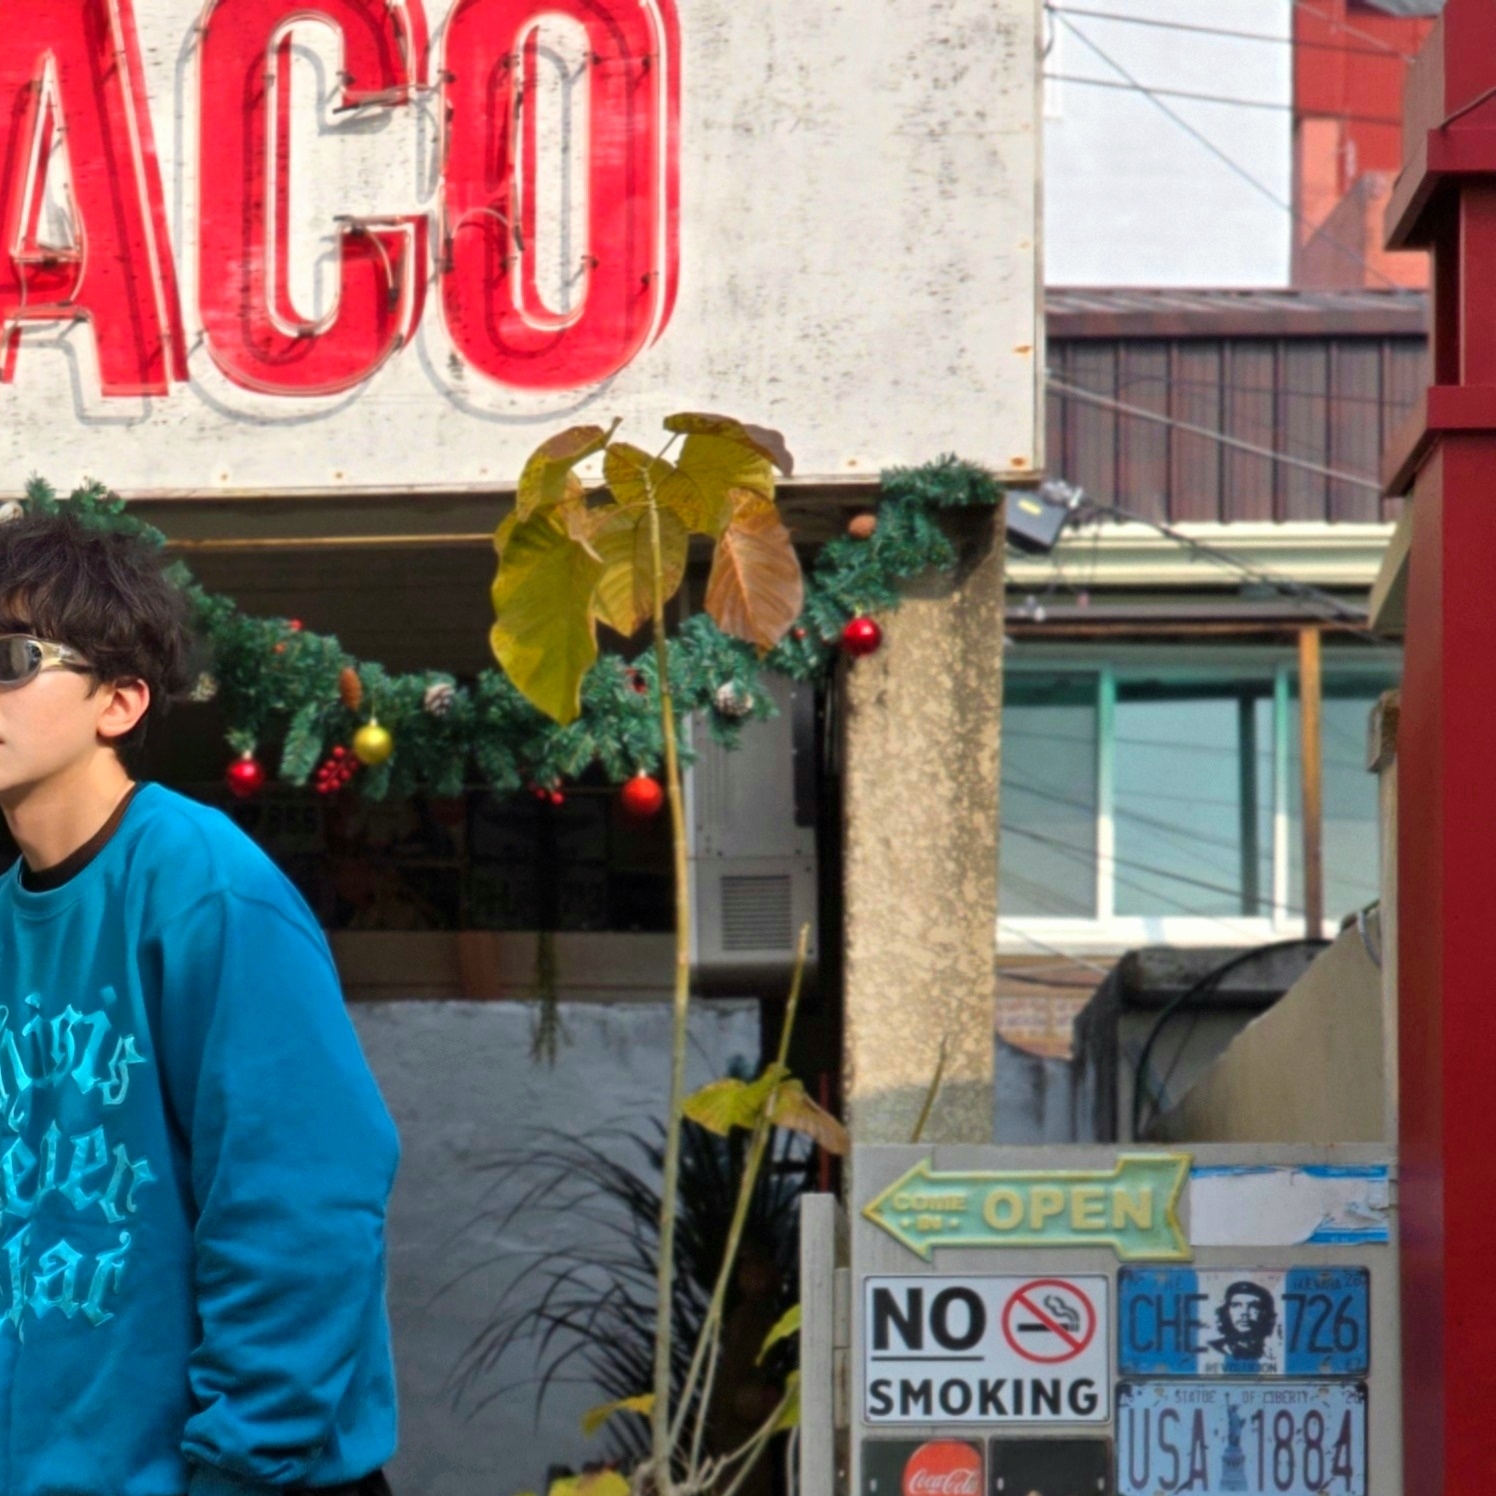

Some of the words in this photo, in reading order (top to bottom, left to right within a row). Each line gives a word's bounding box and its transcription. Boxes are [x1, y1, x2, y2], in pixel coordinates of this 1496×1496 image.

[892, 1193, 967, 1211] COME
[983, 1189, 1153, 1231] OPEN
[871, 1287, 986, 1350] NO
[1129, 1294, 1208, 1353] CHE
[1281, 1293, 1359, 1353] 726
[869, 1378, 1098, 1417] SMOKING
[1128, 1408, 1208, 1491] USA
[1252, 1408, 1353, 1491] 1884
